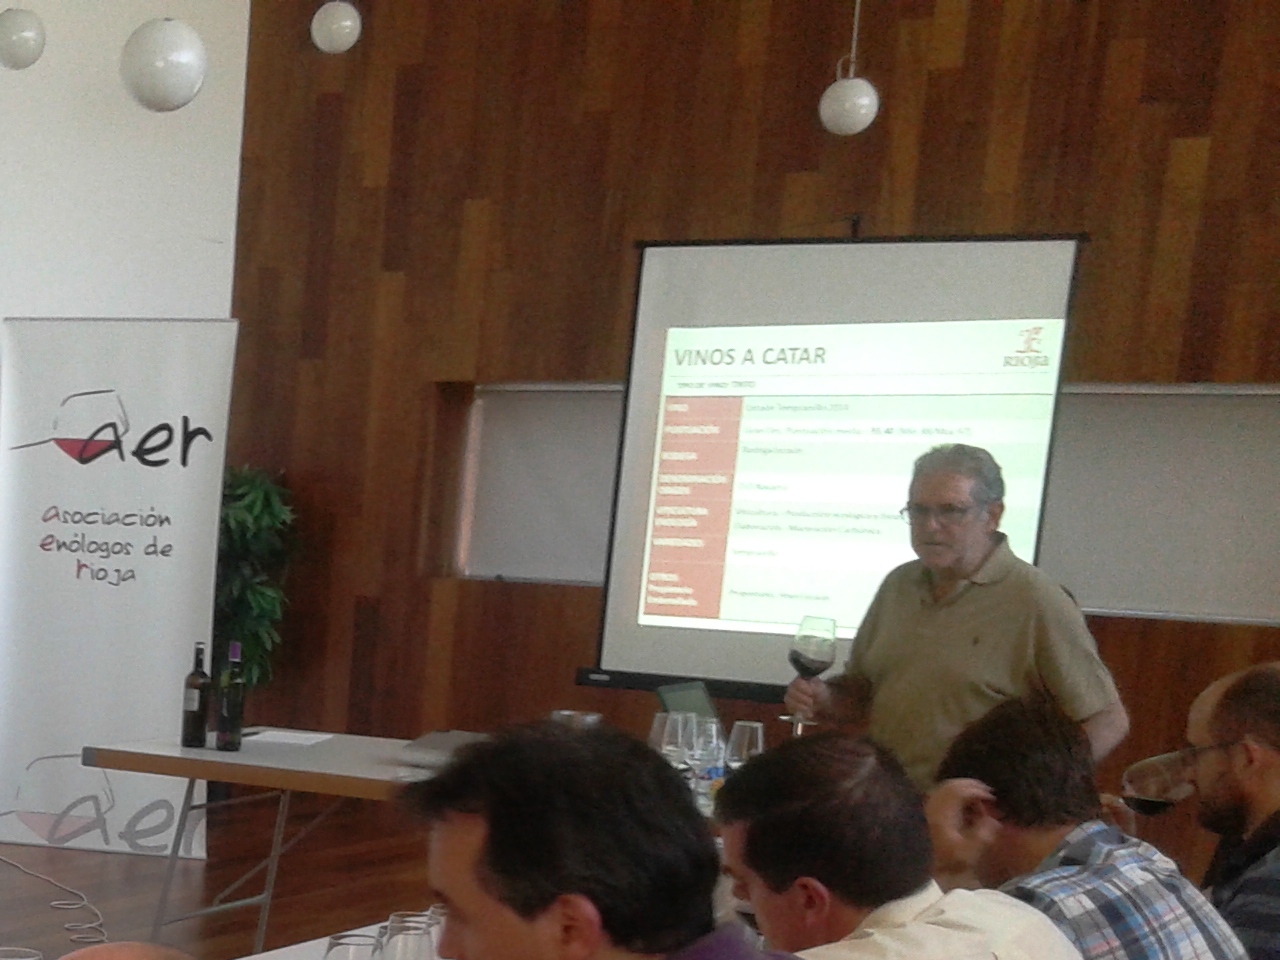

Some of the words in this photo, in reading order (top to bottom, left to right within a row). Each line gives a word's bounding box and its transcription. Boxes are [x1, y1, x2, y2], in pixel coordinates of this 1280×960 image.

[674, 348, 736, 366] VINOS
[741, 348, 755, 365] A
[761, 347, 827, 365] CATAR
[80, 415, 214, 468] aer
[41, 505, 172, 528] asociación
[39, 533, 135, 559] enólogos
[143, 535, 173, 558] de
[75, 558, 136, 586] rioja
